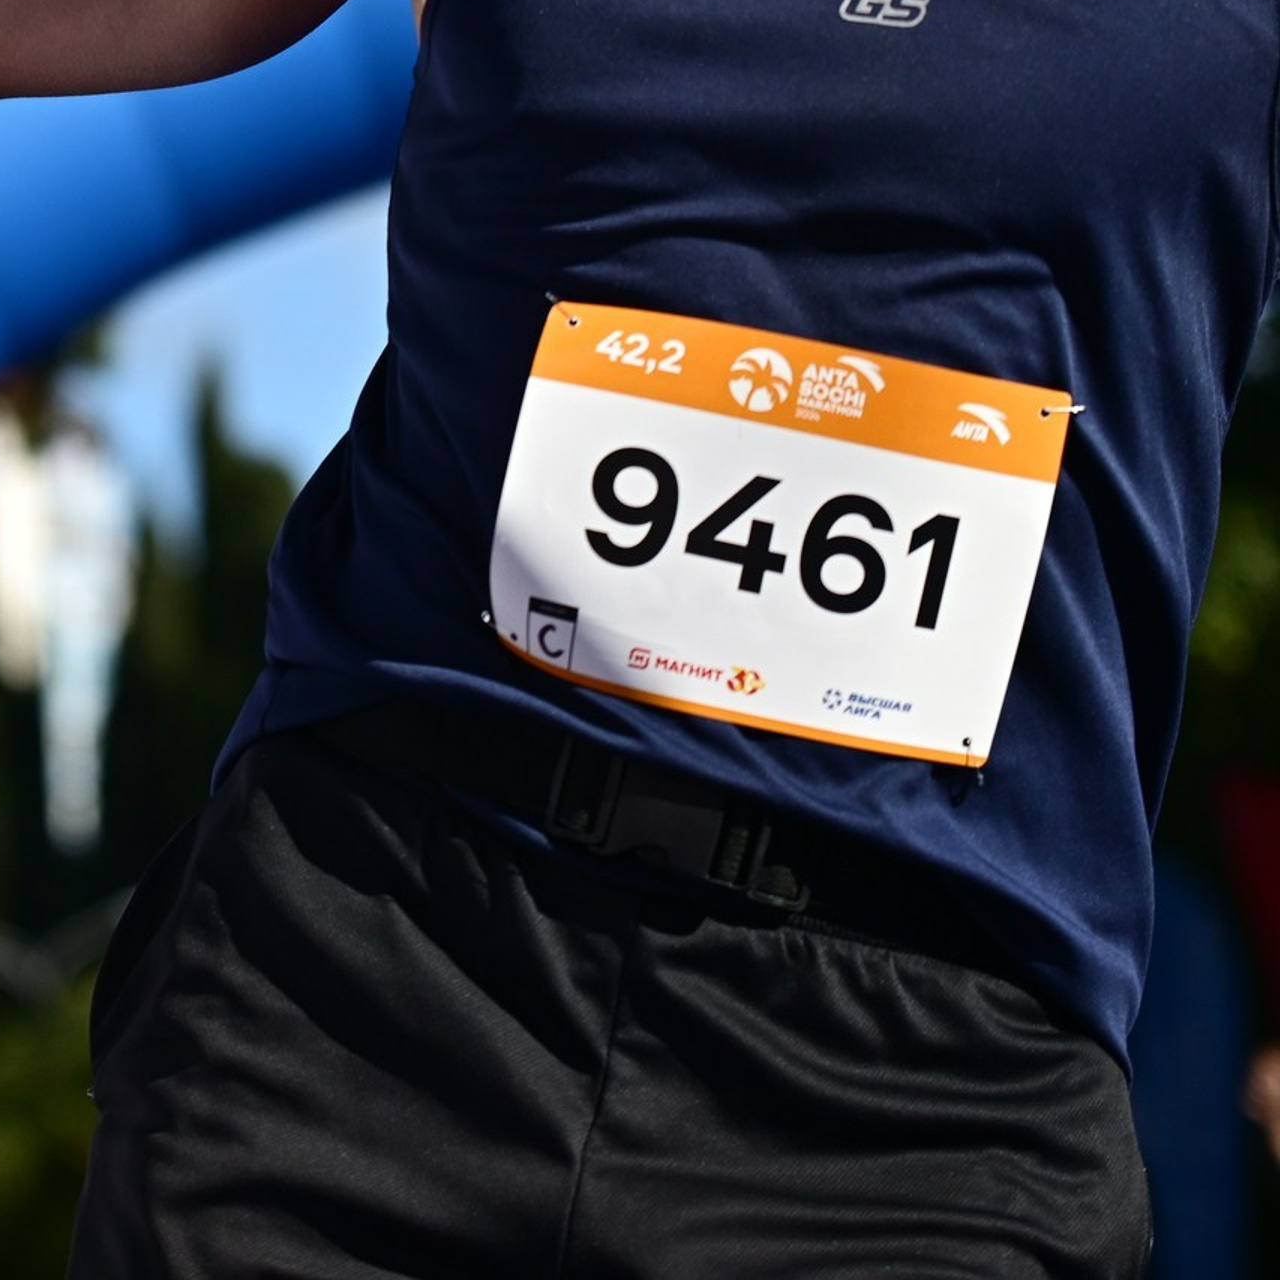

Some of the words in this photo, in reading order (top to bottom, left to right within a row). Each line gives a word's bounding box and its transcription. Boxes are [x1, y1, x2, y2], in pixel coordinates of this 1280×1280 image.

[595, 329, 687, 375] 42,2
[802, 363, 859, 390] ANTA
[799, 380, 866, 409] SOCHI
[584, 447, 960, 630] 9461
[654, 656, 723, 681] МАГНИТ
[843, 705, 881, 721] ЛИГА
[848, 693, 912, 713] ВЫСШАЯ
